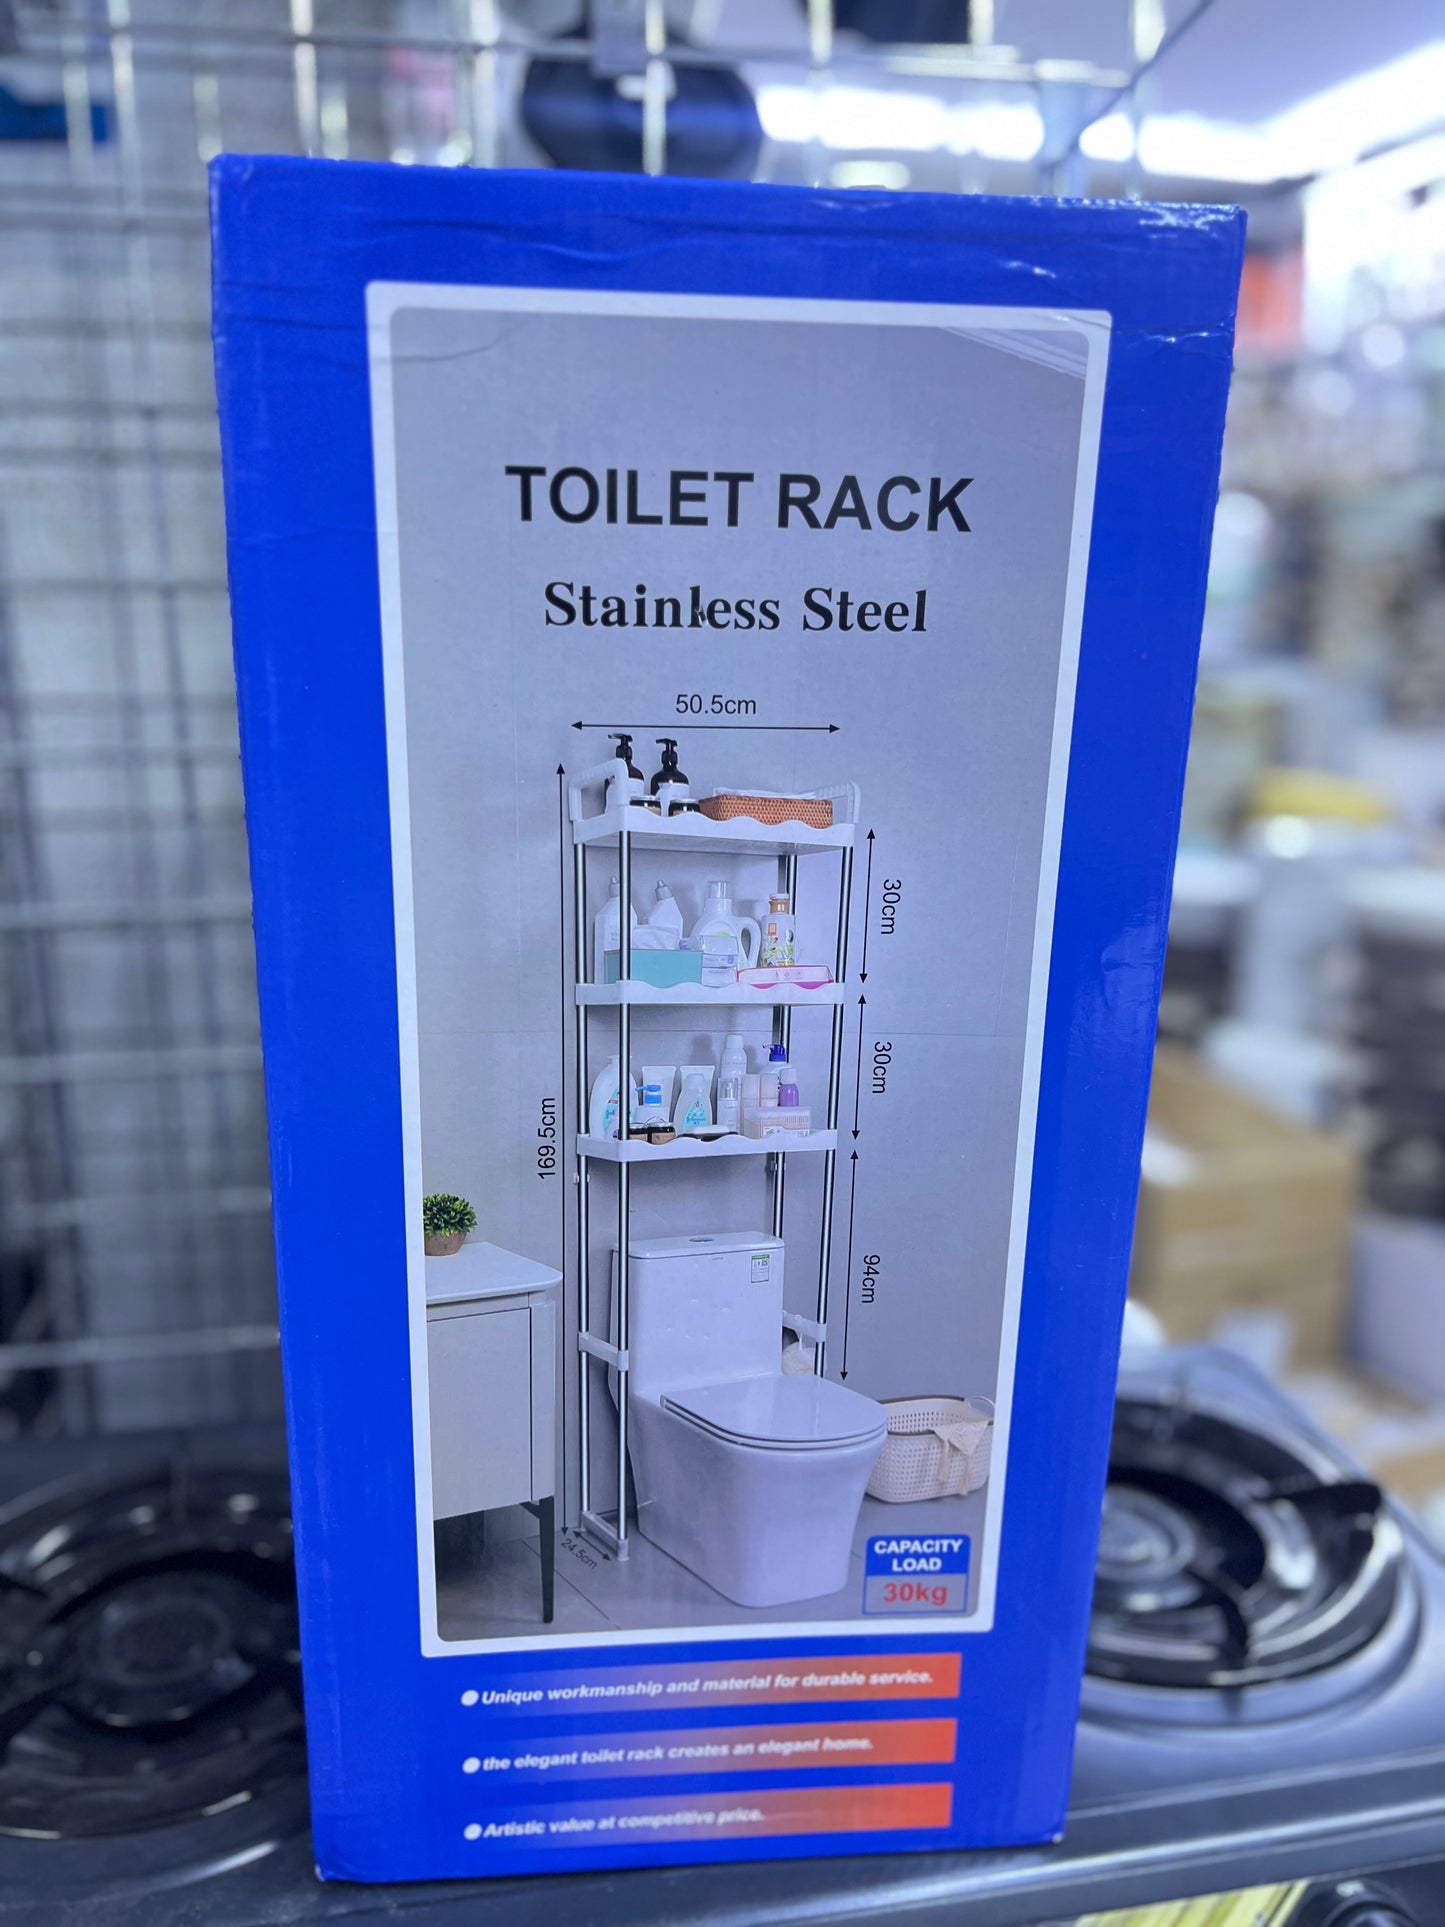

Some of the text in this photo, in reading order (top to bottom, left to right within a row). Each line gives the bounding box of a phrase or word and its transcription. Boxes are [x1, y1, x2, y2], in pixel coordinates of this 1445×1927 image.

[504, 465, 975, 533] TOILET RACK
[544, 581, 928, 632] Stainless Steel
[675, 693, 757, 716] 50.5cm
[880, 879, 902, 935] 30cm
[872, 1041, 892, 1094] 30cm
[537, 1097, 556, 1180] 169.5cm
[861, 1254, 881, 1304] 94cm
[560, 1538, 598, 1570] 24.5cm
[873, 1539, 963, 1555] CAPACITY
[891, 1556, 943, 1572] LOAD
[882, 1582, 948, 1607] 30kg
[481, 1669, 934, 1706] Unique workmanship and material for durable service.
[482, 1735, 874, 1772] the elegant toilet rack creates an elegant home.
[482, 1807, 764, 1839] Artistic value at competitive price.
